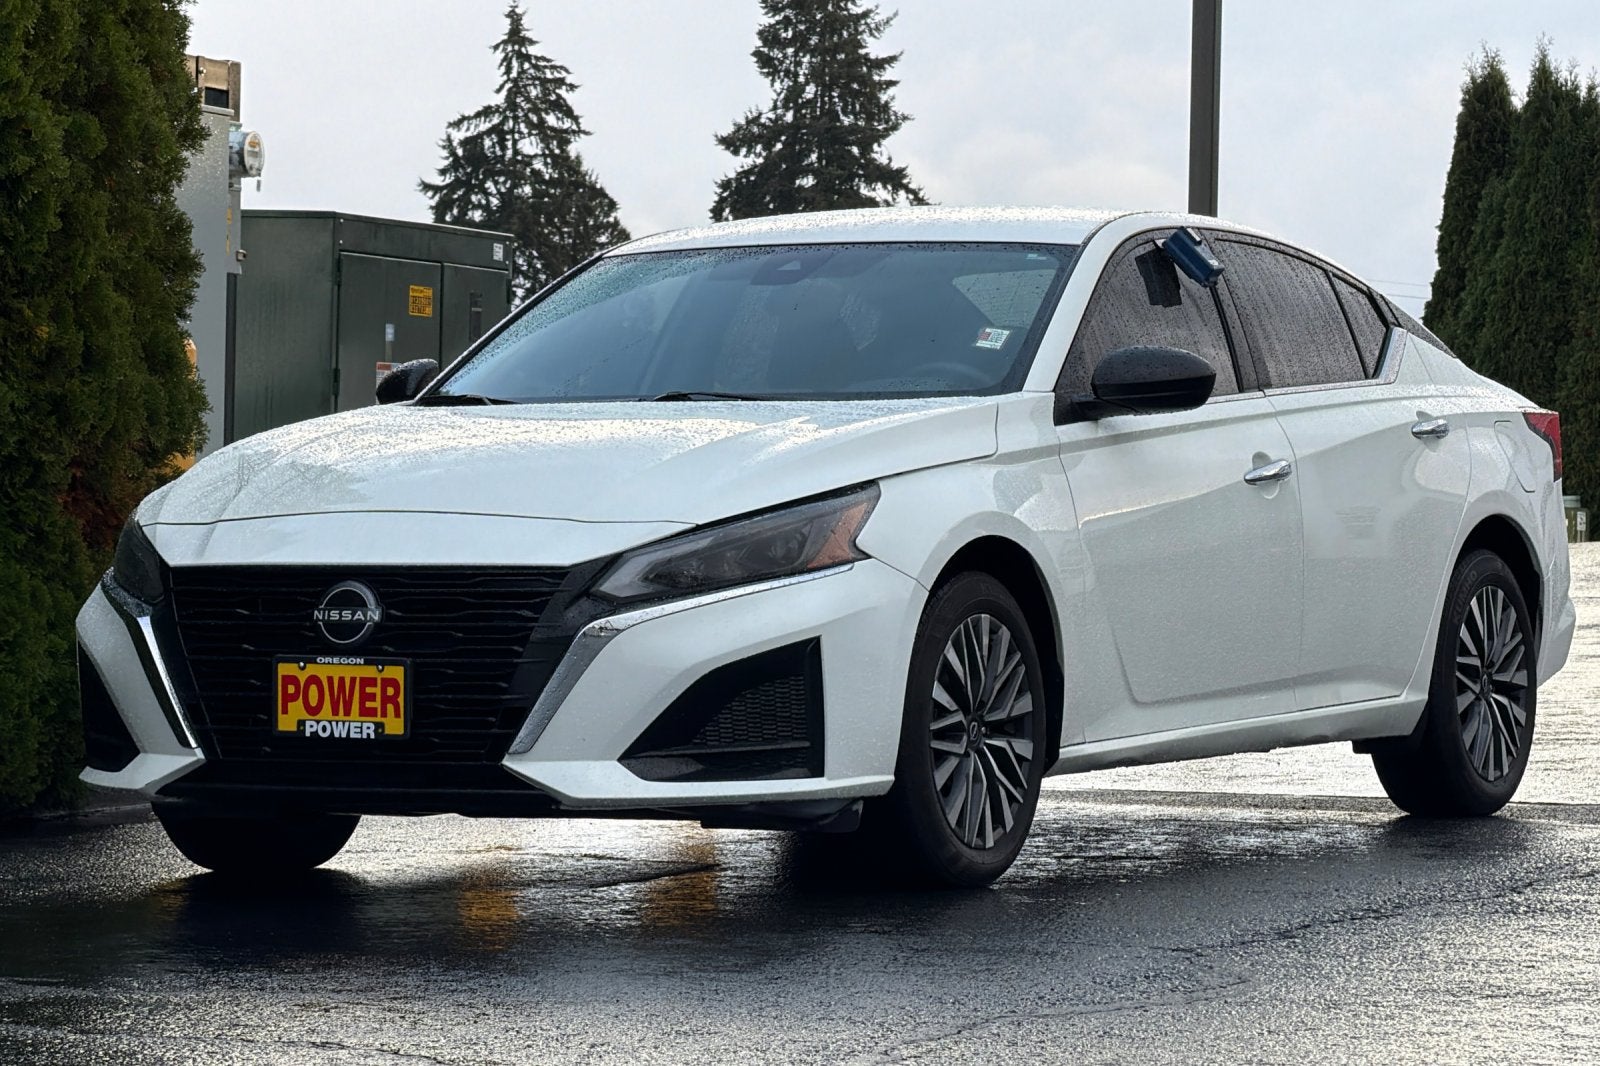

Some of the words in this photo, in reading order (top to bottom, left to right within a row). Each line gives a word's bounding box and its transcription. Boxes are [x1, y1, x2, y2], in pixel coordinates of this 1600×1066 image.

[314, 610, 379, 620] NISSAN
[280, 674, 402, 719] POWER
[305, 720, 375, 739] POWER
